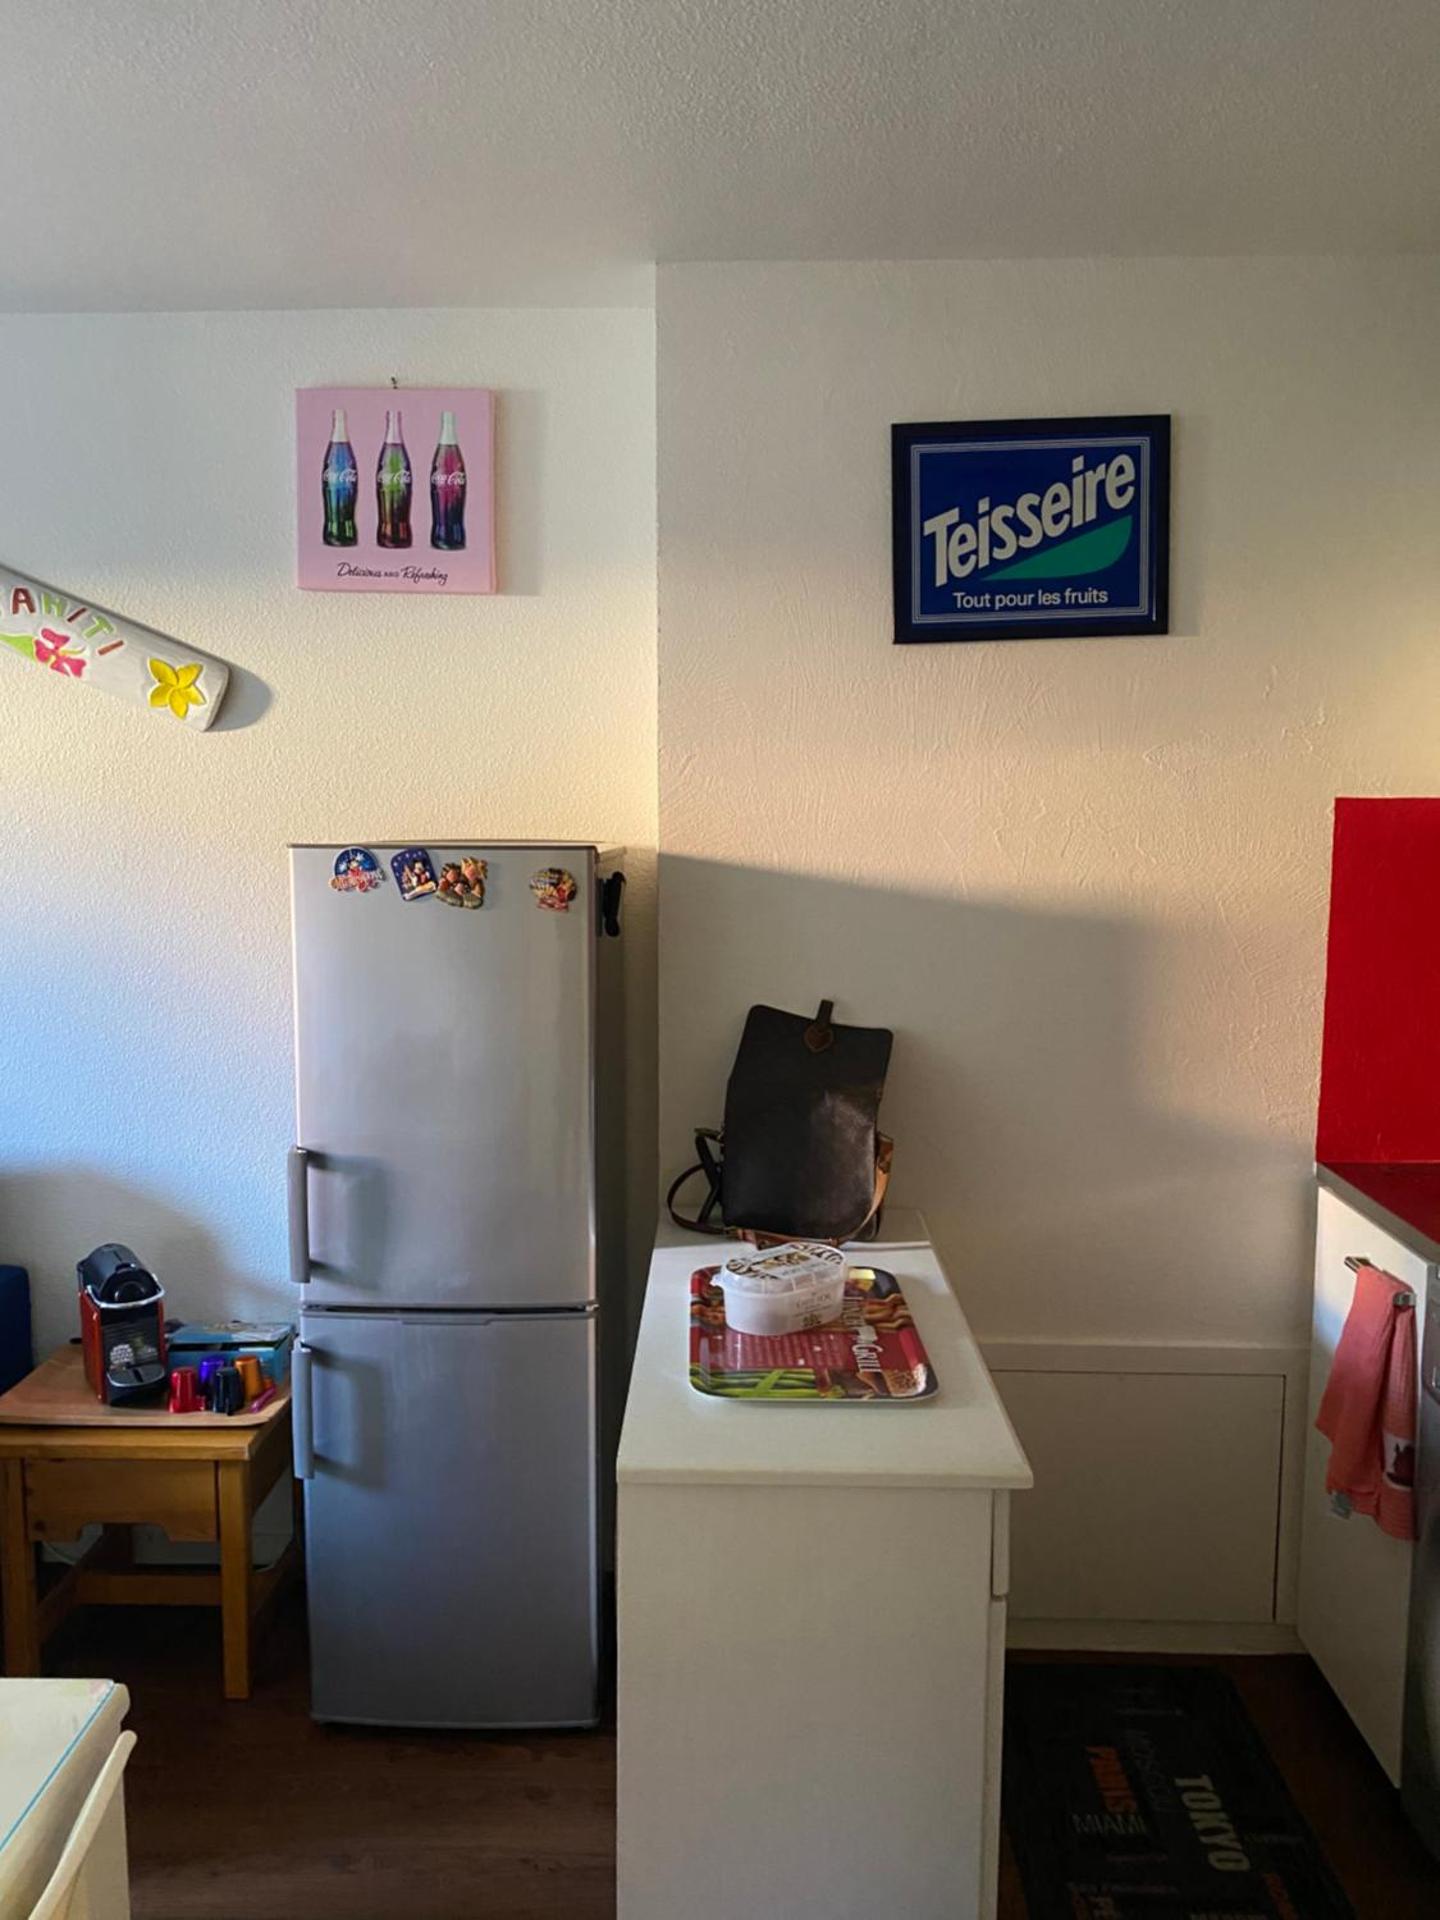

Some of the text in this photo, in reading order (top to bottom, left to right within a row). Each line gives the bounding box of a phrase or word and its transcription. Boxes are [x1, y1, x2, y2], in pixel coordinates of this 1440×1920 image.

[923, 453, 1136, 588] Teisseire
[337, 562, 382, 577] Delicious
[400, 566, 448, 585] Refreshing
[953, 587, 1109, 609] Tout pour les fruits
[0, 587, 125, 656] AHITI
[1071, 1814, 1147, 1836] MIAMI
[1174, 1774, 1251, 1872] TOKYO
